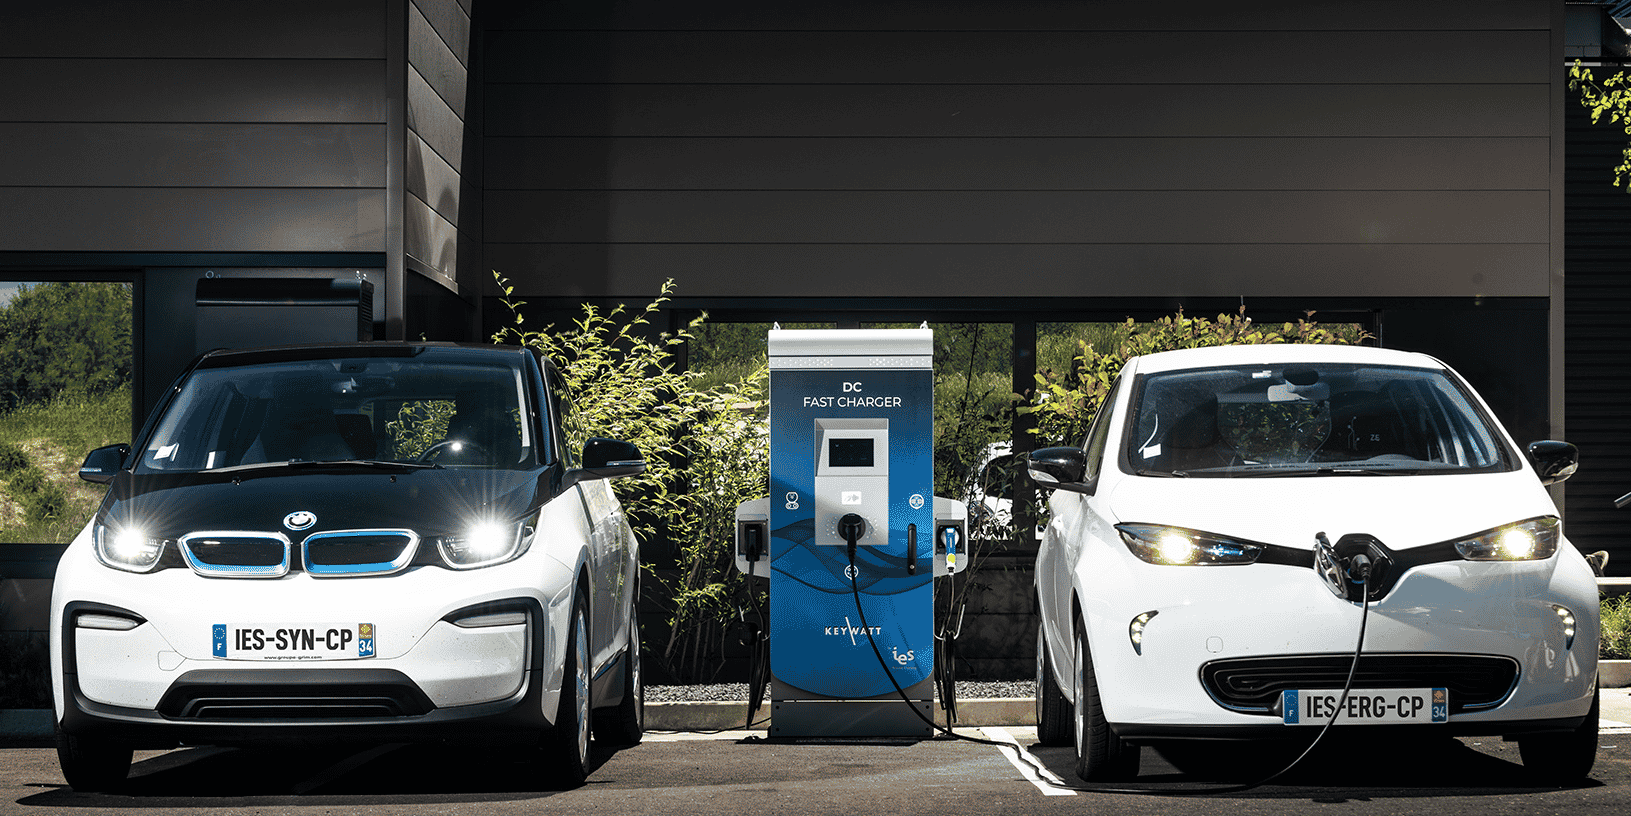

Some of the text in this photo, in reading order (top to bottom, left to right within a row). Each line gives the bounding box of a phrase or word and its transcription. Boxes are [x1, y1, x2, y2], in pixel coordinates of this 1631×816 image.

[843, 382, 862, 392] DC
[803, 397, 902, 407] FAST CHARGER
[216, 629, 373, 653] F IES-SYN-CP 34
[892, 646, 915, 665] ies
[1306, 696, 1424, 718] IES-ERG-CP
[1433, 705, 1445, 718] 34
